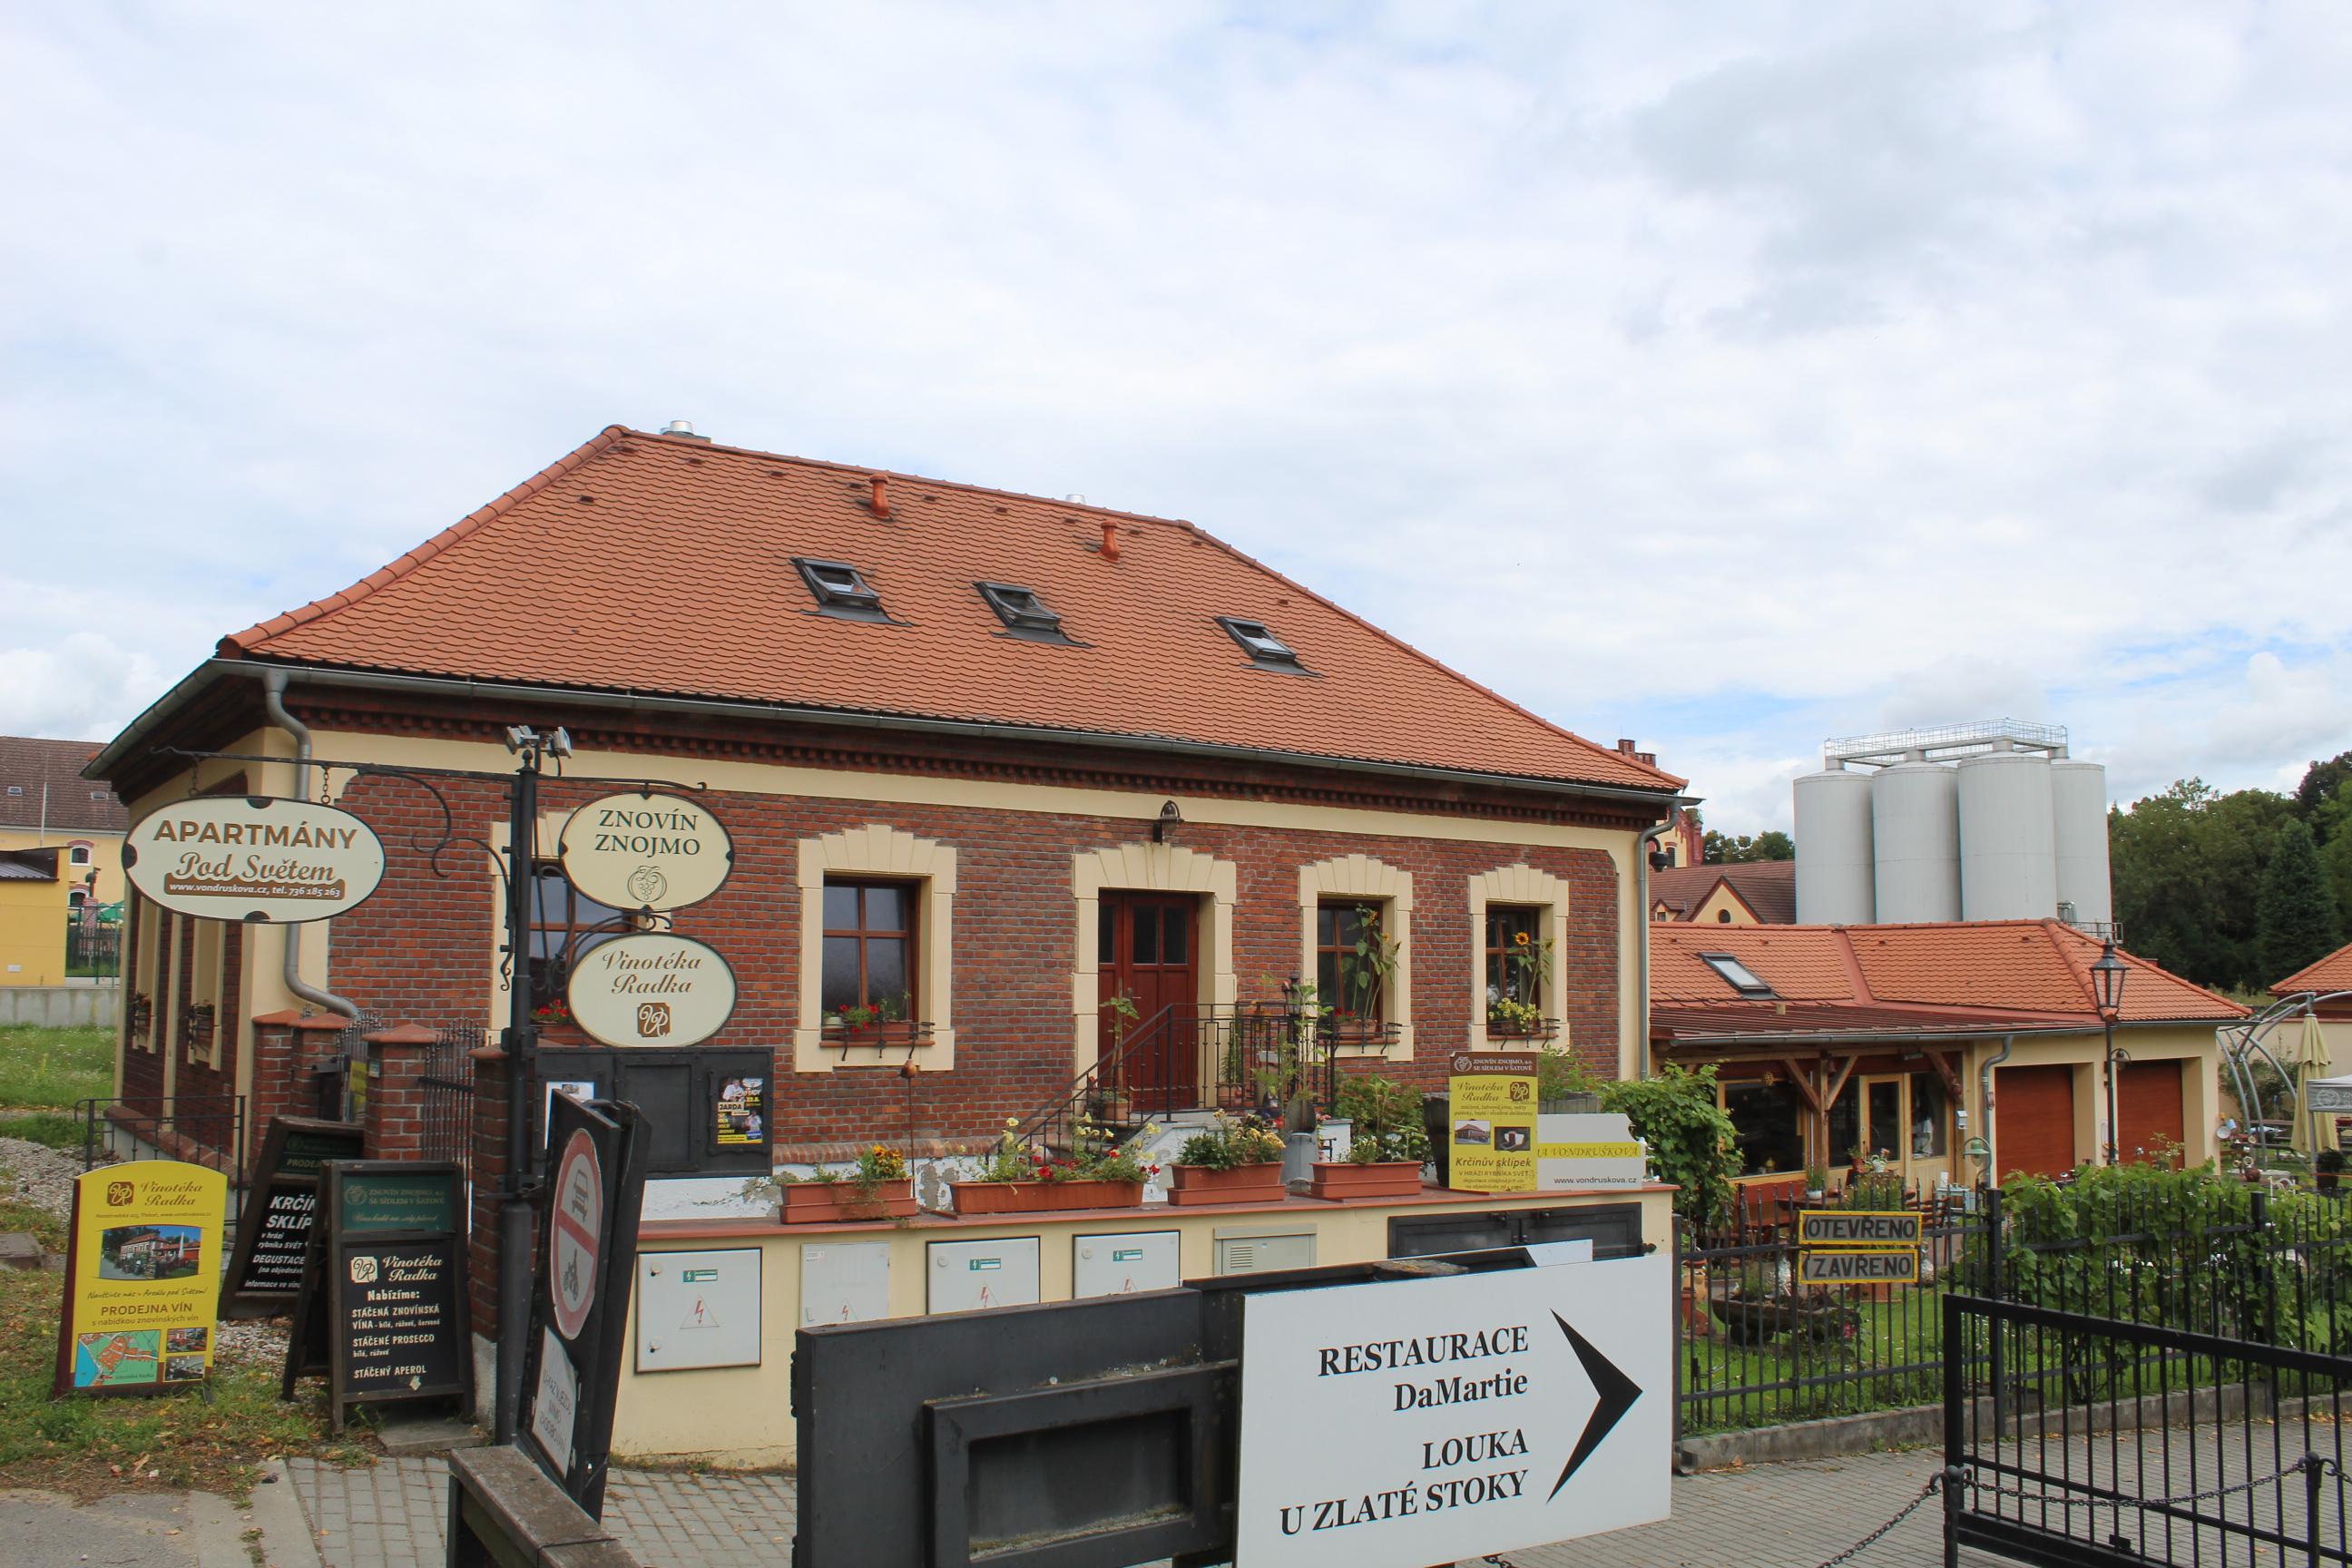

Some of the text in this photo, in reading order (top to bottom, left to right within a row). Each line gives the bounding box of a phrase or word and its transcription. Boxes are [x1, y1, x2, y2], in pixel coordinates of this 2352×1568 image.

[599, 808, 698, 831] ZNOVÍN
[153, 819, 358, 849] APARTMÁNY
[595, 834, 701, 858] ZNOJMO
[175, 851, 336, 882] Pod Světem
[170, 883, 340, 898] www.vondruskova.cz, tel. 736 185 263
[603, 950, 702, 971] Vinotéka
[612, 973, 693, 994] Radka
[1457, 1082, 1504, 1091] Vinotéka
[1461, 1092, 1500, 1101] Radka
[1553, 1145, 1639, 1158] VONDRUŠKOVÁ
[1455, 1157, 1532, 1169] Krčínův sklípek
[140, 1181, 203, 1193] Vinotéka
[1553, 1176, 1637, 1184] www.vondruskova.cz
[144, 1193, 197, 1206] Radka
[1808, 1215, 1916, 1239] OTEVŘENO
[258, 1241, 283, 1250] rybníka
[252, 1254, 306, 1264] DEGUSTACE
[382, 1254, 443, 1269] Vinotéka
[1813, 1254, 1912, 1278] ZAVŘENO
[388, 1268, 437, 1282] Radka
[245, 1279, 278, 1288] informace
[367, 1289, 420, 1301] Nabízíme:
[101, 1301, 193, 1316] PRODEJNA VÍN
[351, 1303, 440, 1318] STÁČENÁ ZNOVÍNSKÁ
[97, 1317, 135, 1326] nabídkou
[187, 1314, 199, 1322] vín
[352, 1318, 374, 1329] VÍNA
[352, 1334, 435, 1348] STÁČENÉ PROSECCO
[1318, 1325, 1529, 1377] RESTAURACE
[353, 1365, 426, 1379] STÁČENÝ APEROL
[1394, 1367, 1529, 1412] DaMartie
[1422, 1427, 1529, 1470] LOUKA
[1279, 1469, 1528, 1535] U ZLATÉ STOKY
